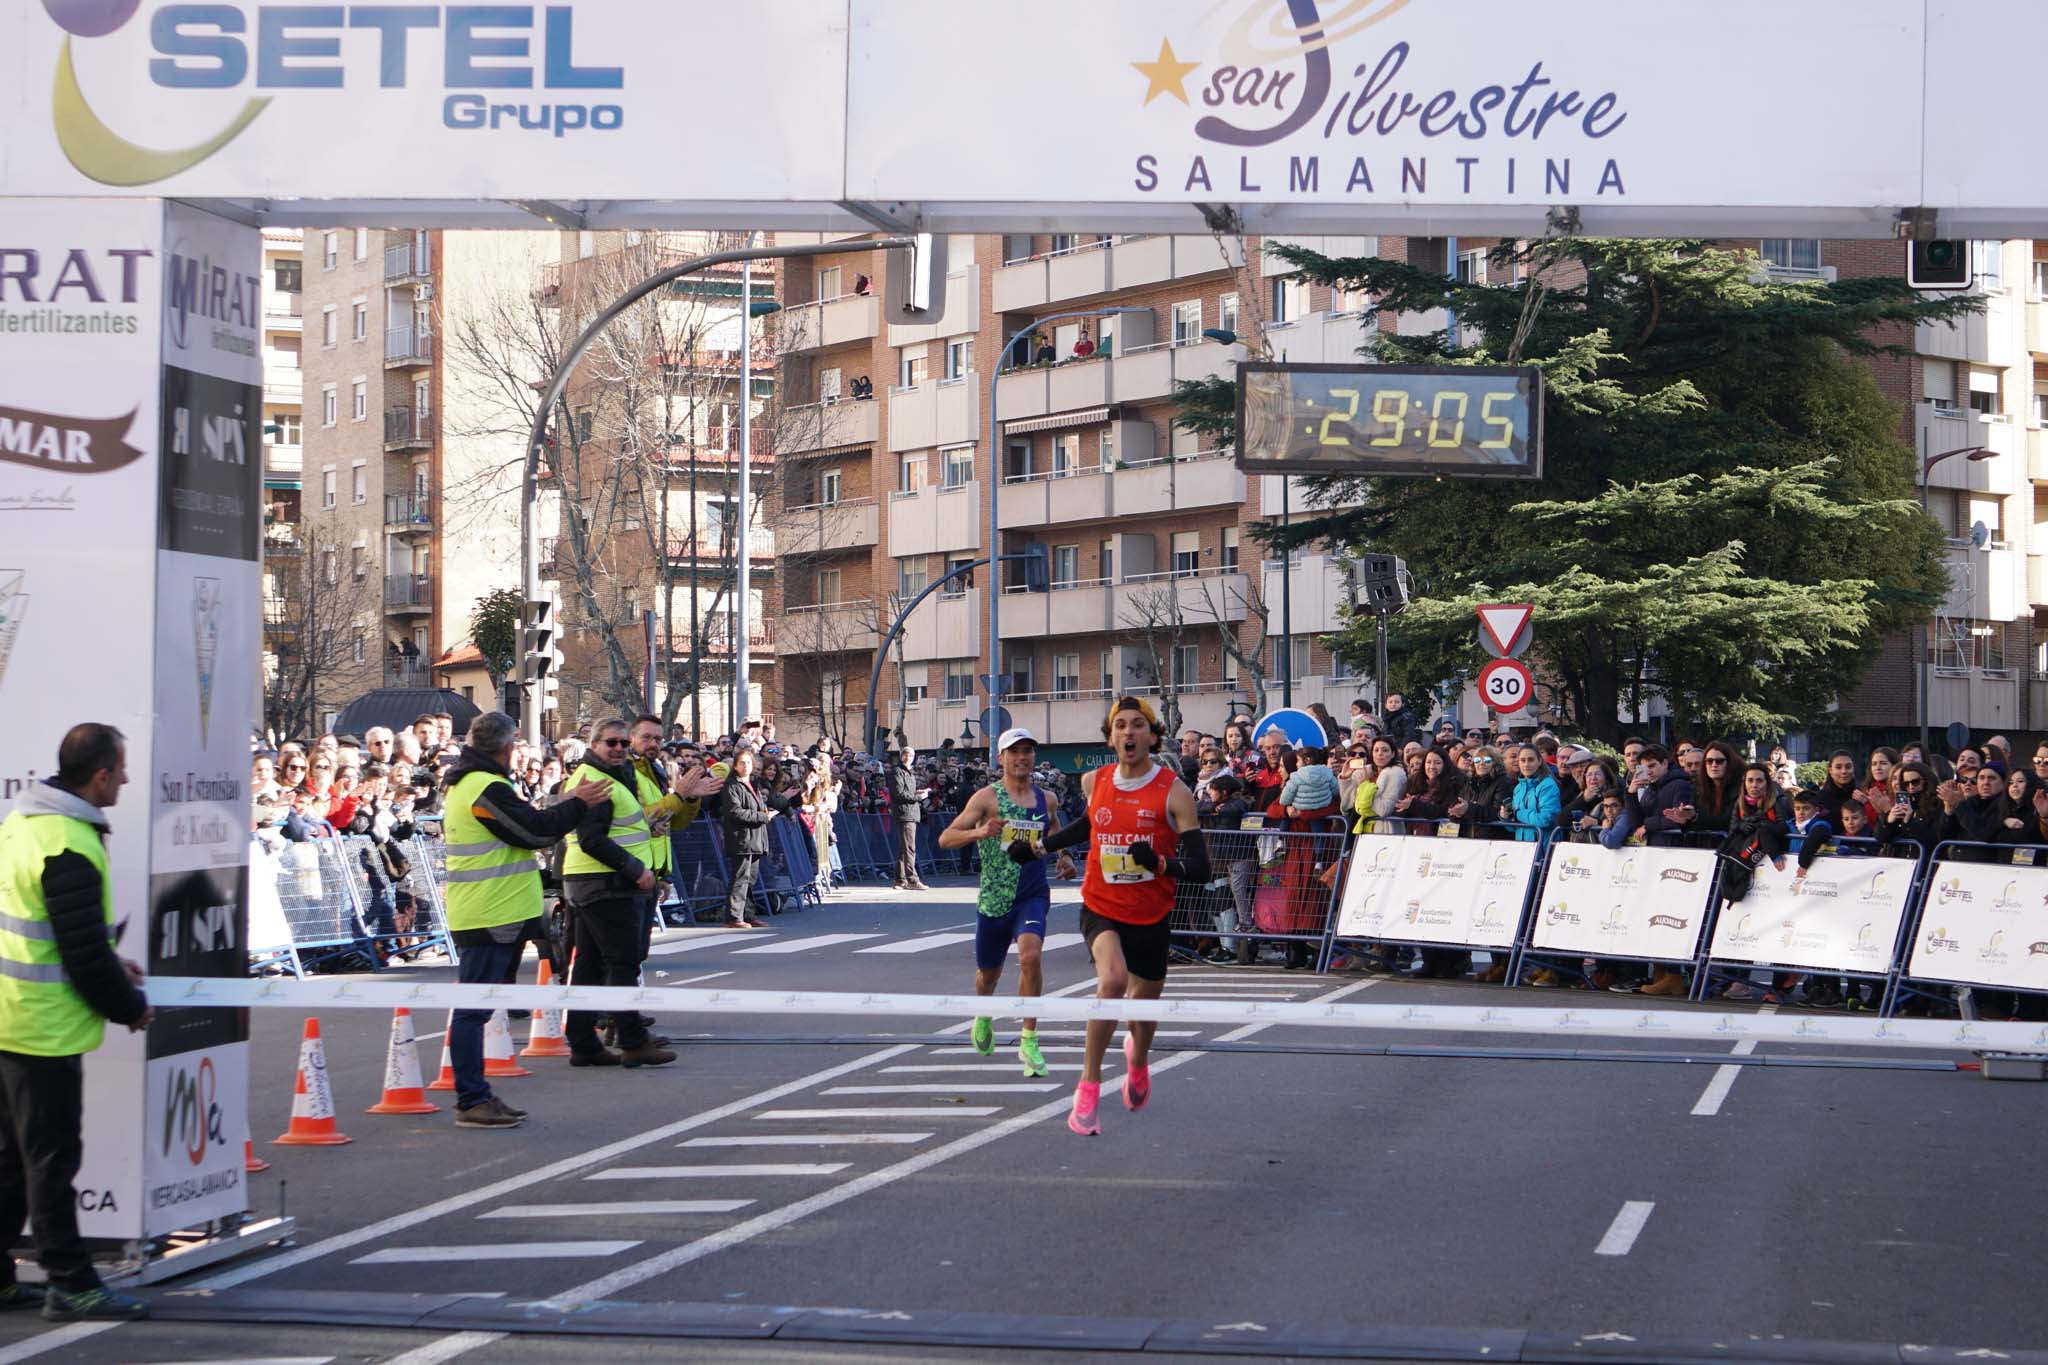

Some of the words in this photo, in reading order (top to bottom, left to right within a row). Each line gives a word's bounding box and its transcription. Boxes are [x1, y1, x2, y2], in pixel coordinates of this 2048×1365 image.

[149, 4, 624, 90] SETEL
[443, 93, 624, 137] Grupo
[1134, 155, 1626, 196] SALMANTINA
[1490, 677, 1521, 696] 30
[1086, 754, 1103, 768] CAJA
[160, 771, 184, 804] San
[1121, 855, 1126, 871] 1
[1565, 867, 1592, 876] SETEL
[1945, 889, 1974, 899] SETEL
[1553, 912, 1581, 922] SETEL
[1932, 938, 1960, 949] SETEL
